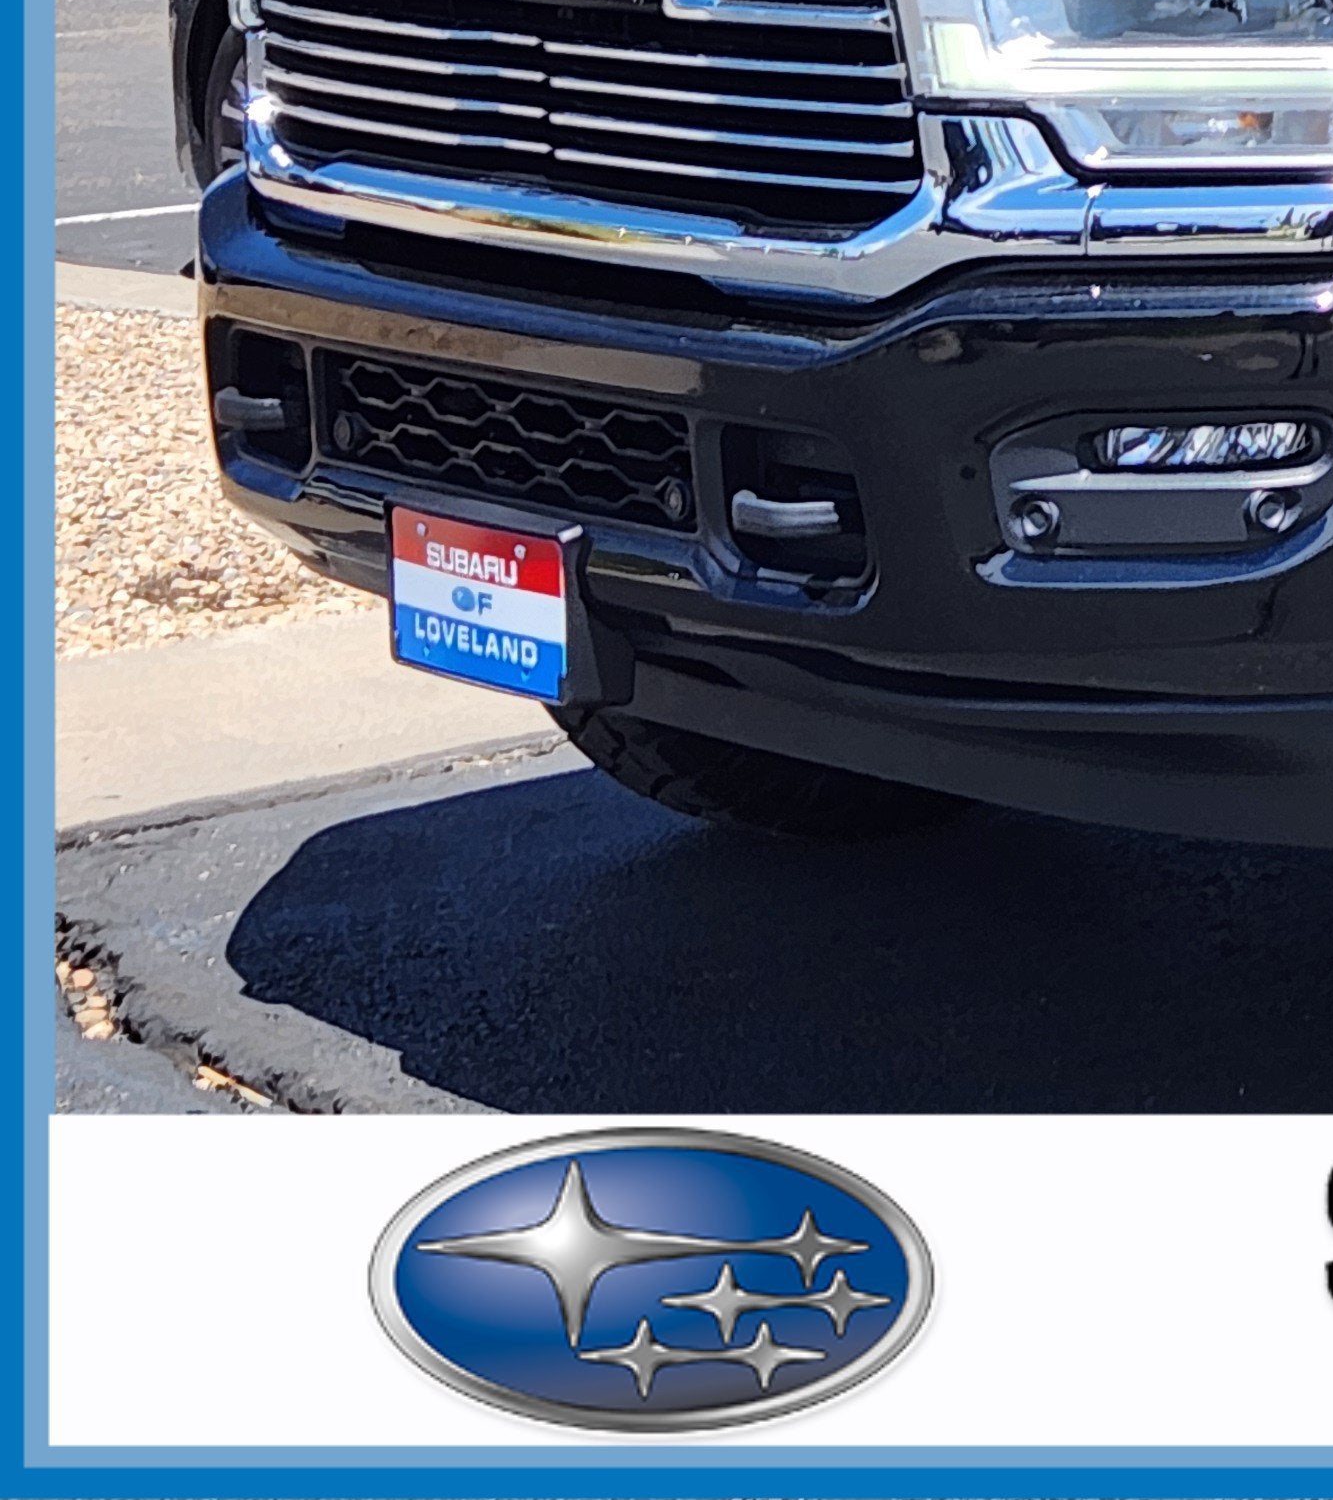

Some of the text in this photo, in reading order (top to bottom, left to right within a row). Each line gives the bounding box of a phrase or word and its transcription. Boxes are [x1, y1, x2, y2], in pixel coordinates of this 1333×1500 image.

[427, 542, 518, 587] SUBARU
[451, 586, 493, 616] OF
[414, 612, 539, 669] LOVELAND
